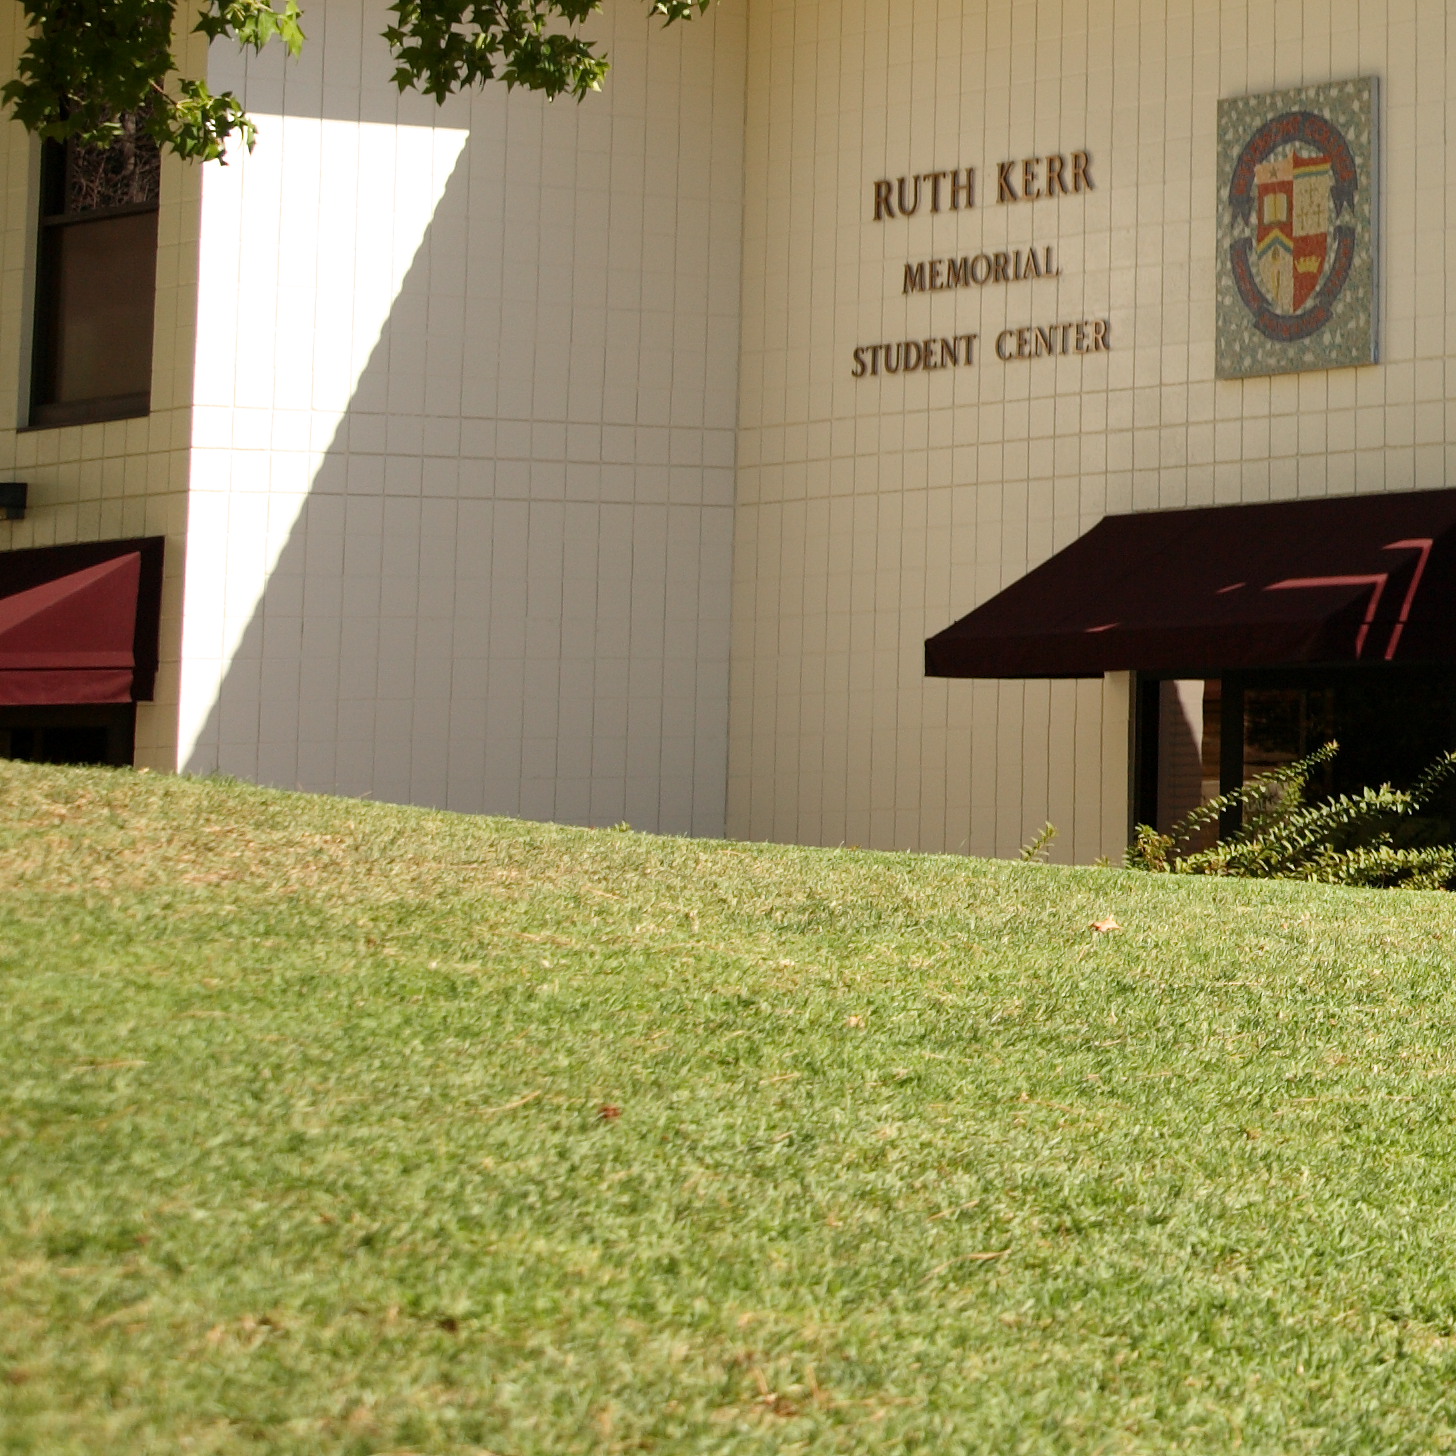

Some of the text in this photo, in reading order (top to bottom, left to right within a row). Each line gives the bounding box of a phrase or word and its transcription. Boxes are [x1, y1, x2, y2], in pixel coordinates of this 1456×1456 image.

[872, 151, 1096, 221] RUTH KERR
[902, 245, 1062, 295] MEMORIAL
[851, 317, 1111, 378] STUDENT CENTER
